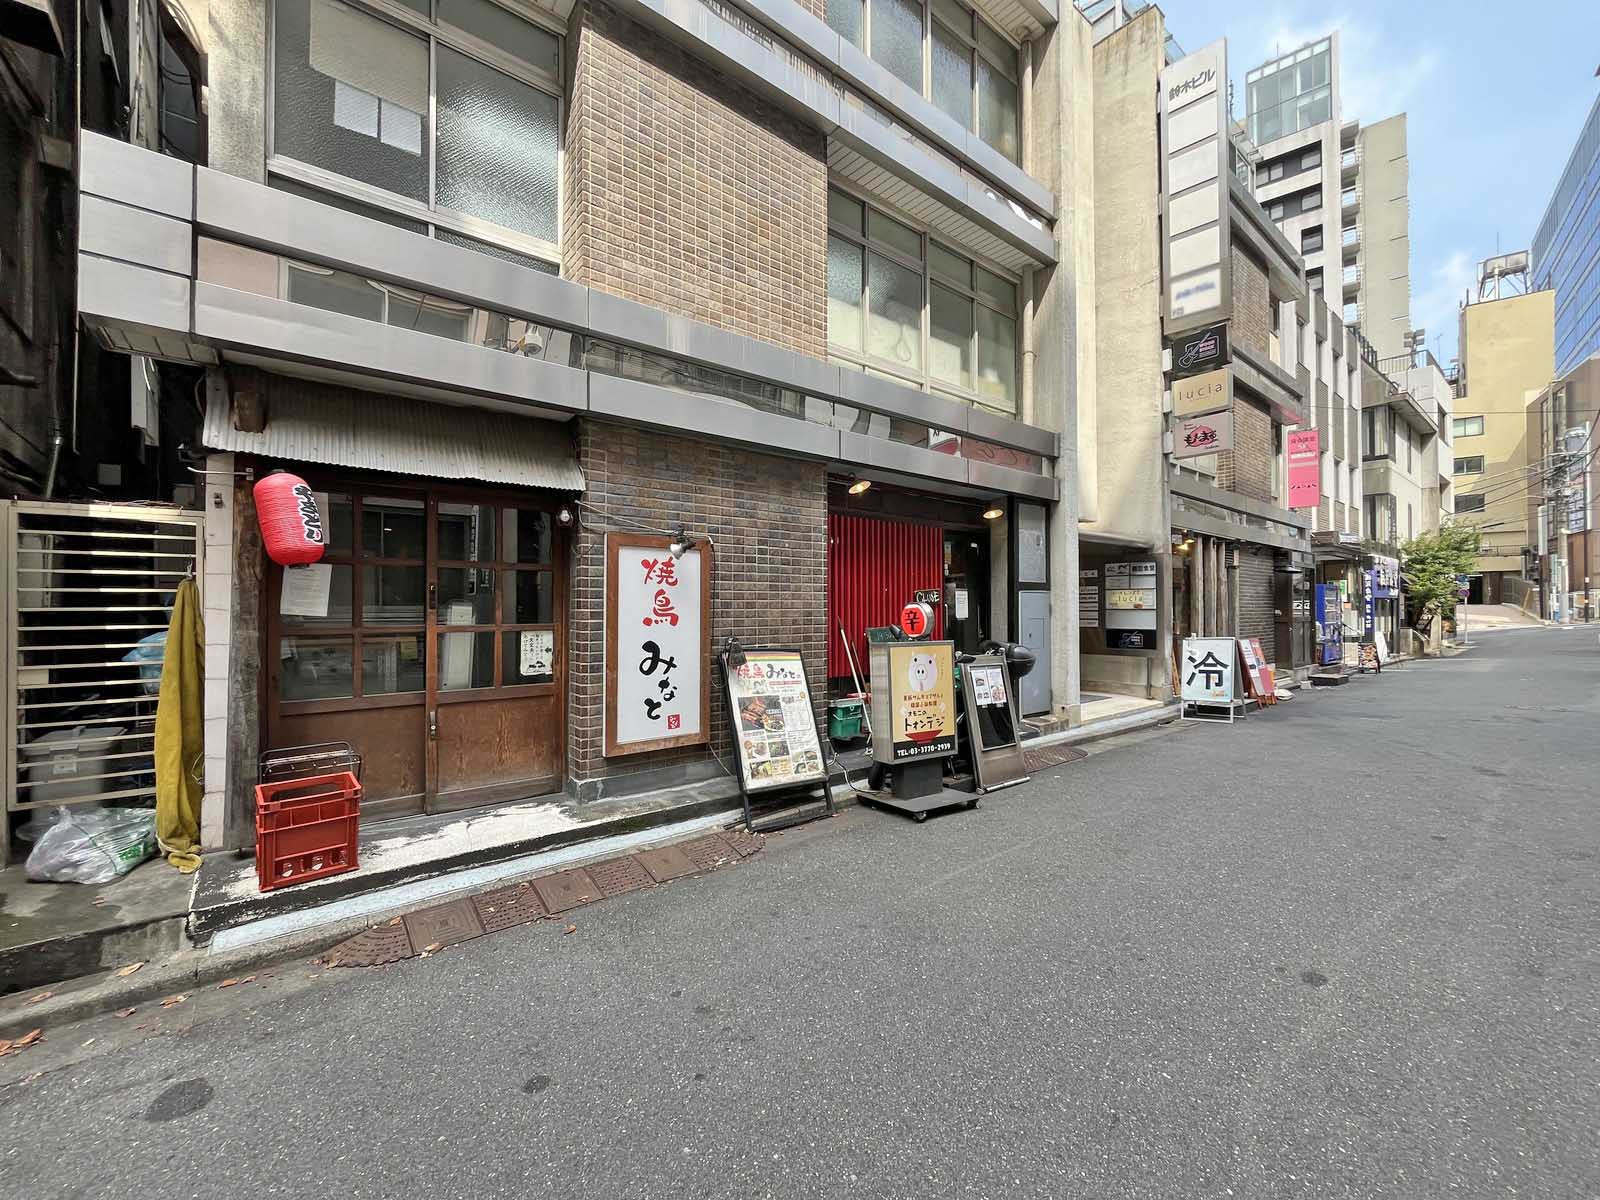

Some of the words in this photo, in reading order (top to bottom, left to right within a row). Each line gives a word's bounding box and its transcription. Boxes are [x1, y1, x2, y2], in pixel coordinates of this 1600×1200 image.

[1168, 68, 1216, 101] 鈴木ビル
[1178, 382, 1224, 401] lucia
[640, 556, 680, 627] 焼鳥
[639, 640, 678, 720] みなと
[766, 663, 796, 679] みなと
[1185, 650, 1230, 690] 冷
